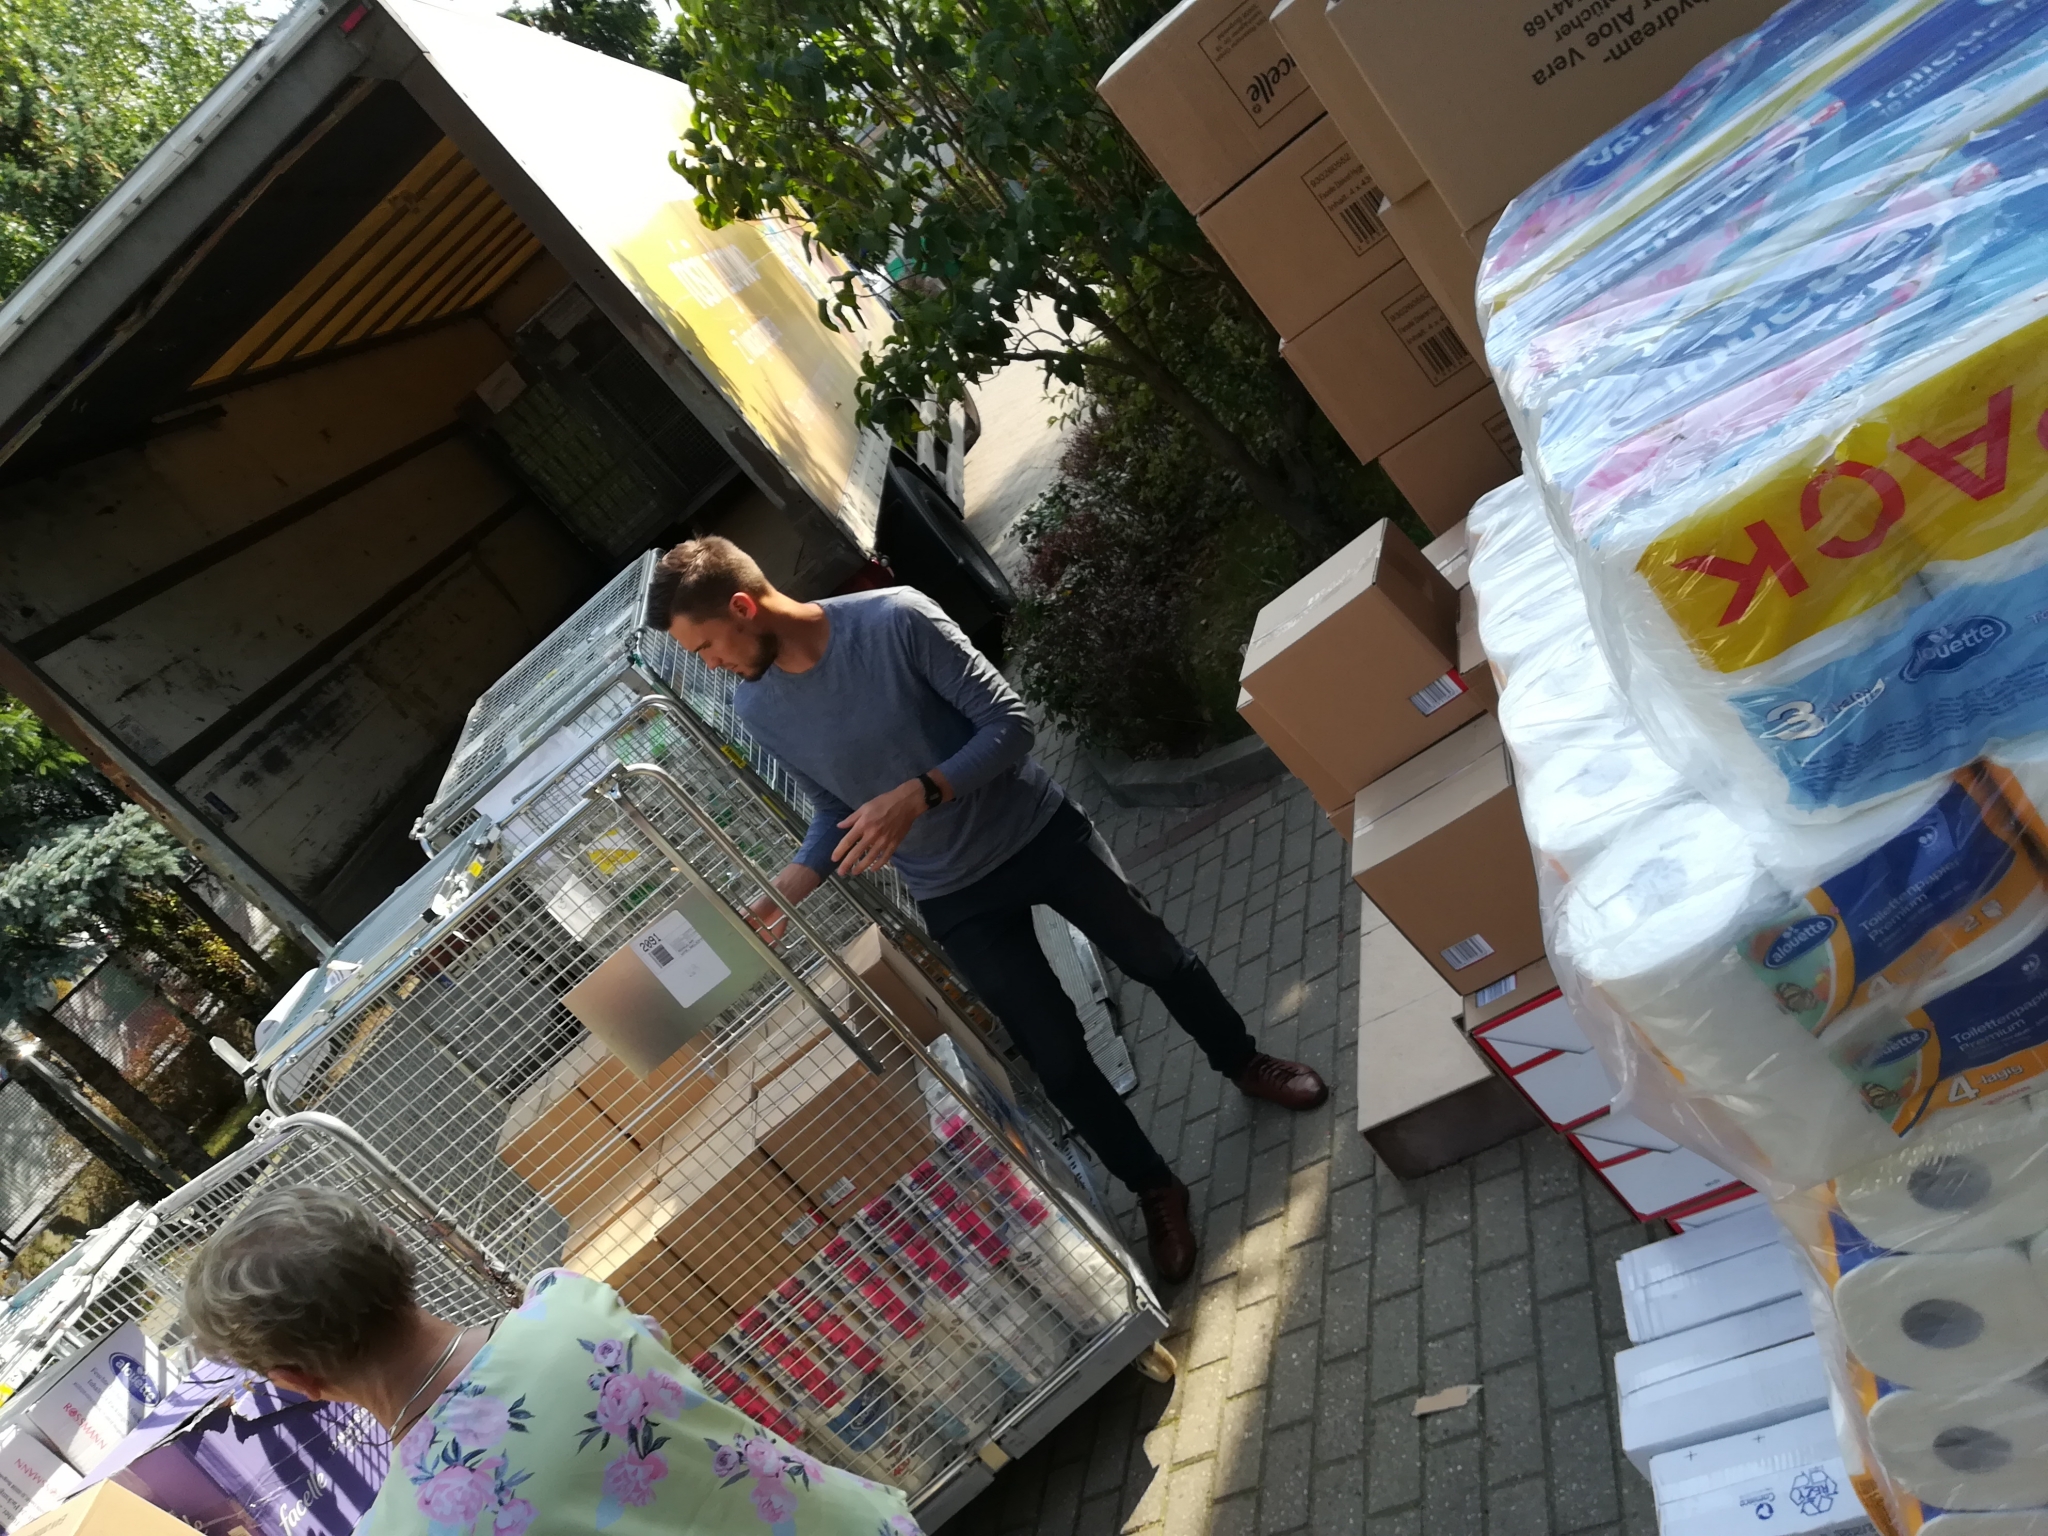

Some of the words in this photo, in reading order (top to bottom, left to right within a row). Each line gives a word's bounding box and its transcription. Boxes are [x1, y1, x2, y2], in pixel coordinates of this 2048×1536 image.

[1585, 5, 1635, 48] Aloe
[1602, 0, 1709, 63] ydream-
[1245, 52, 1298, 104] celle
[1531, 48, 1586, 86] Vera
[1670, 385, 2048, 628] ACK
[638, 932, 661, 952] 2091
[1772, 921, 1829, 964] alouette
[115, 1358, 157, 1405] alouette
[63, 1402, 107, 1450] ROSSMANN
[278, 1470, 328, 1536] facelle
